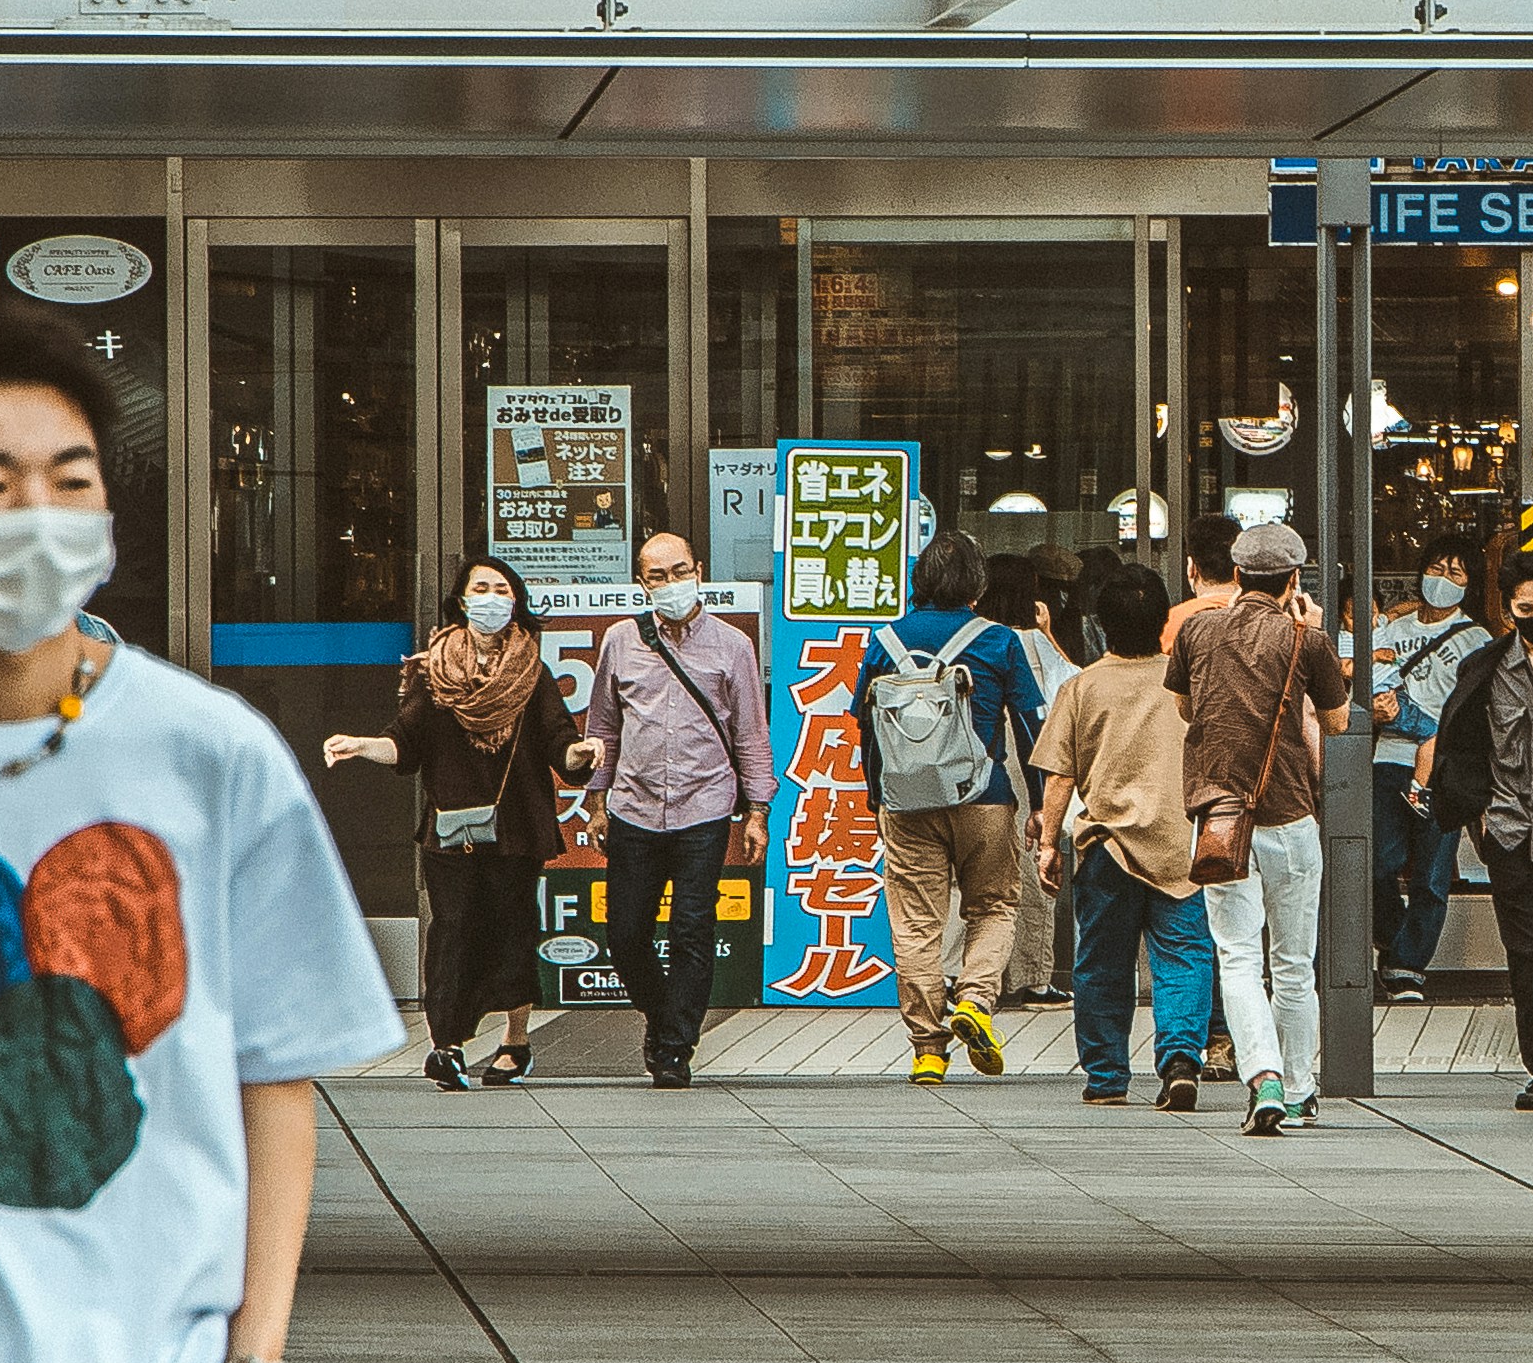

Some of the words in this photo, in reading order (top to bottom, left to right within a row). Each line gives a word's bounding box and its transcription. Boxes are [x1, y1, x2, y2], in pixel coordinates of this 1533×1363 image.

[1369, 193, 1460, 234] IFE
[43, 264, 82, 276] CAFE
[496, 406, 622, 424] おみせde受取り
[555, 443, 618, 461] ネットで
[568, 462, 605, 481] 注文
[797, 460, 894, 503] 省エネ
[499, 501, 567, 519] おみせで
[507, 521, 558, 538] 受取り
[791, 510, 900, 552] エアコン
[791, 557, 898, 609] 買い替え
[589, 593, 627, 607] LIFE
